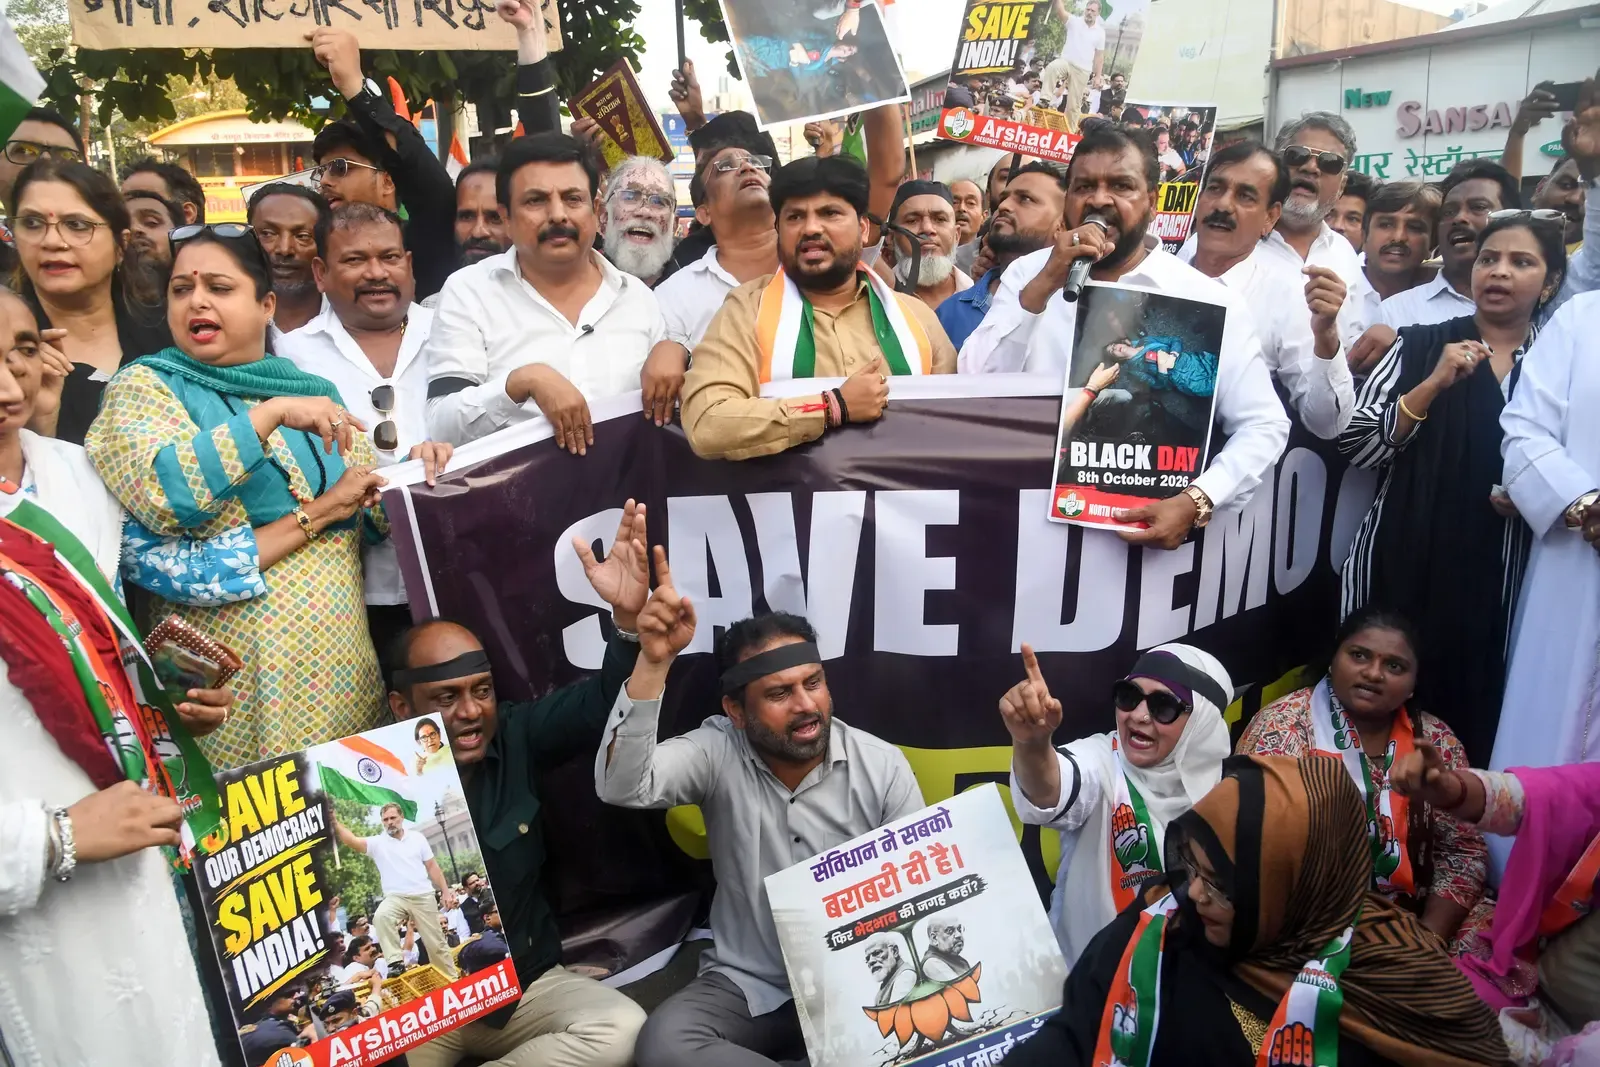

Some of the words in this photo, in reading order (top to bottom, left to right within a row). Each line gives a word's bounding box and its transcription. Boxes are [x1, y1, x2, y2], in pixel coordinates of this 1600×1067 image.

[965, 4, 1034, 41] SAVE
[958, 39, 1019, 68] INDIA!
[980, 119, 1053, 150] Arshad
[1054, 133, 1080, 155] Az
[1396, 100, 1521, 139] SANSA
[973, 135, 999, 146] PRESIDENT
[1001, 141, 1018, 151] NORTH
[1018, 143, 1039, 155] CENTRAL
[1039, 148, 1061, 160] DISTRICT
[1163, 184, 1198, 212] DAY
[1150, 213, 1191, 238] CRACY!
[1070, 441, 1152, 470] BLACK
[1157, 445, 1199, 473] DAY
[1077, 470, 1099, 484] 8th
[1103, 472, 1157, 488] October
[1160, 473, 1189, 488] 2026
[1088, 503, 1111, 518] NORTH
[554, 489, 960, 670] SAVE
[204, 847, 242, 889] OUR
[240, 803, 325, 873] DEMOCRACY
[810, 840, 878, 883] संविधान
[878, 829, 898, 853] ने
[898, 806, 953, 845] सबको
[822, 861, 903, 919] बराबरी
[902, 850, 931, 885] दी
[216, 852, 323, 959] SAVE
[831, 930, 854, 947] फिर
[854, 910, 898, 937] भेदभाव
[899, 904, 916, 921] की
[917, 895, 947, 912] जगह
[946, 878, 979, 900] कहाँ?
[231, 909, 325, 1001] INDIA!
[329, 996, 438, 1067] Arshad
[443, 964, 510, 1017] Azmi
[368, 1042, 394, 1062] NORTH
[394, 1030, 426, 1050] CENTRAL
[426, 1014, 458, 1037] DISTRICT
[458, 1003, 485, 1021] MUMBAI
[484, 986, 519, 1008] CONGRESS
